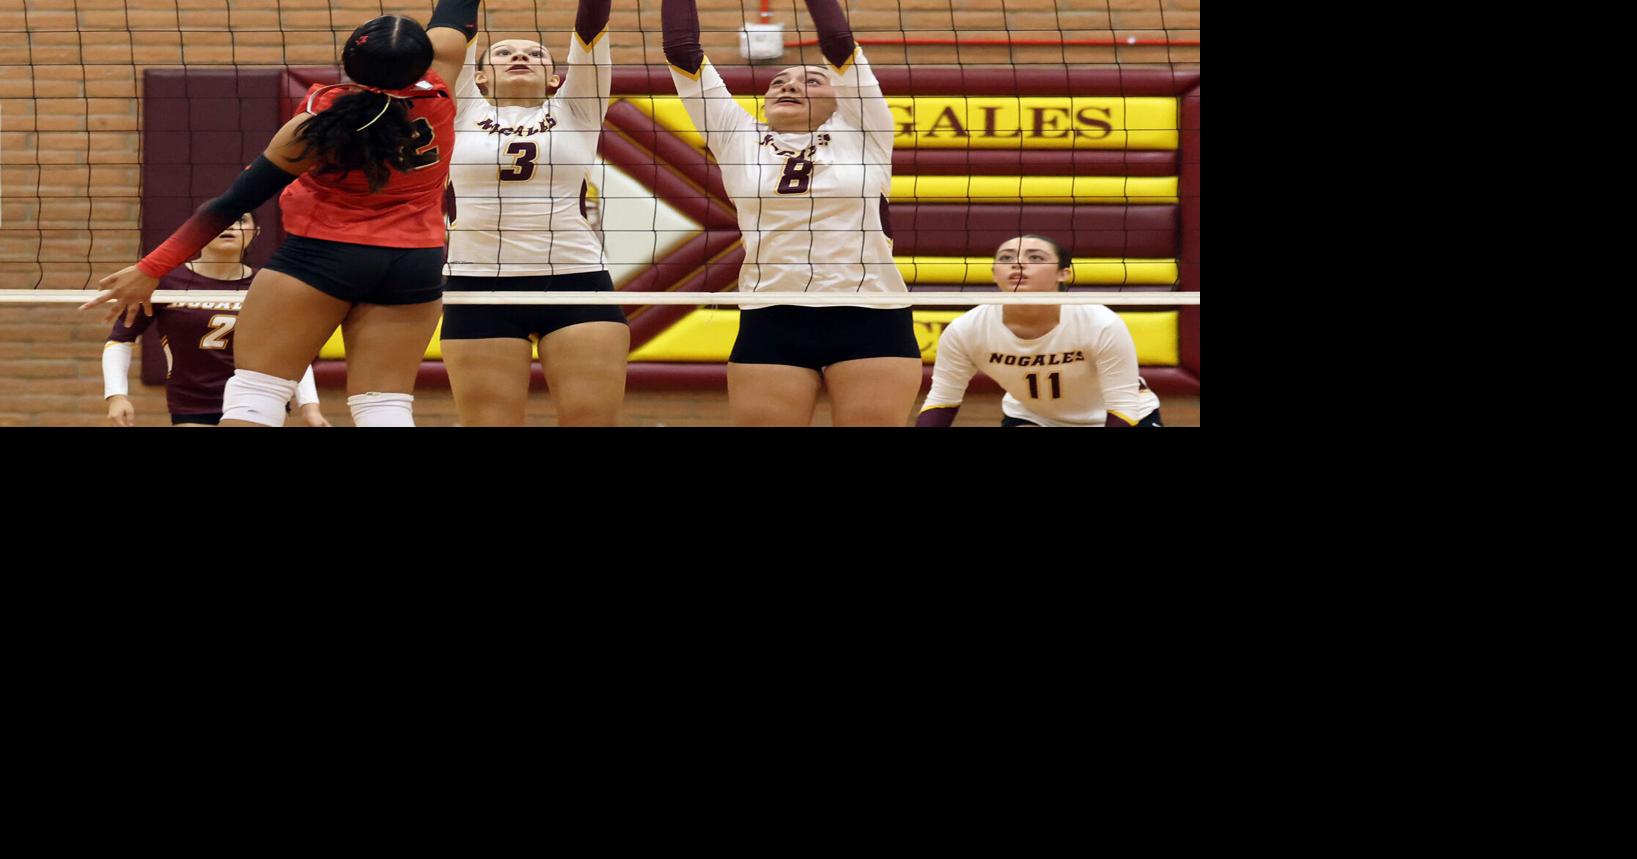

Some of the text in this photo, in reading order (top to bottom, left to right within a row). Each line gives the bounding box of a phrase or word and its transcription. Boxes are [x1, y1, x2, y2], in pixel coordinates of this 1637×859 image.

[497, 141, 540, 182] 3
[775, 156, 813, 195] 8
[199, 313, 240, 349] 2
[989, 351, 1085, 367] NOGALES
[1025, 372, 1062, 400] 11
